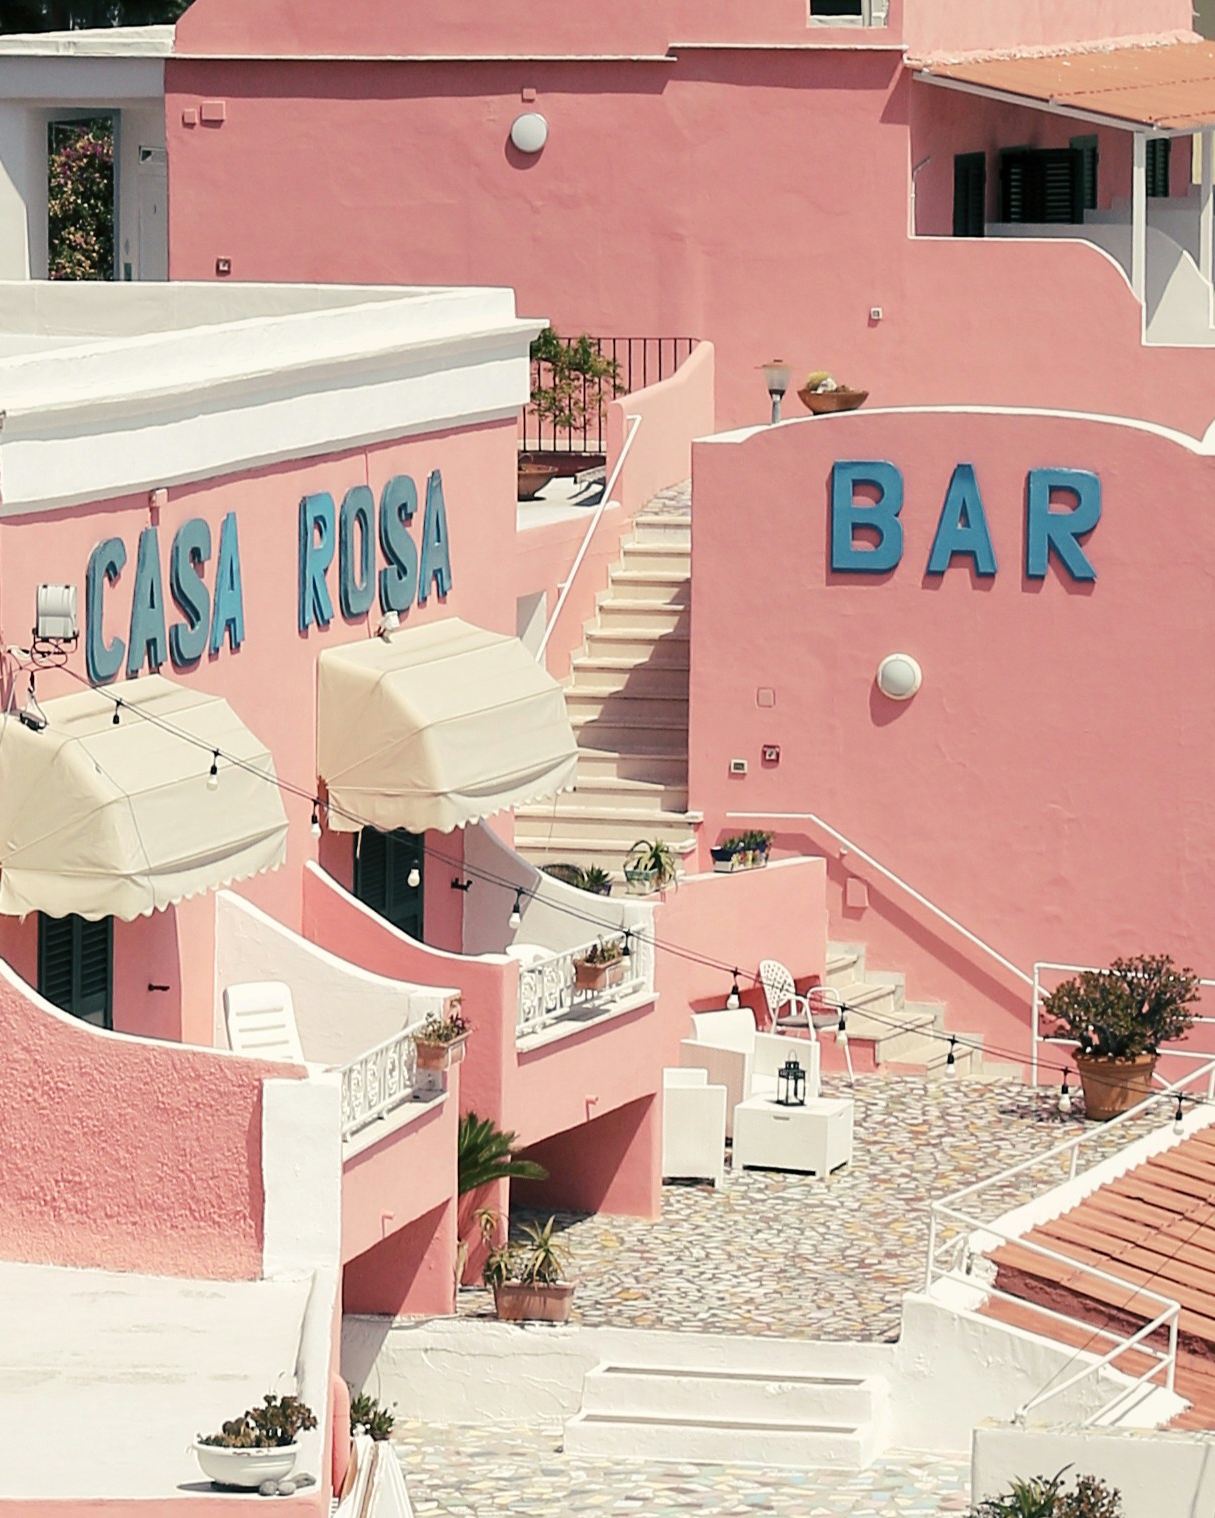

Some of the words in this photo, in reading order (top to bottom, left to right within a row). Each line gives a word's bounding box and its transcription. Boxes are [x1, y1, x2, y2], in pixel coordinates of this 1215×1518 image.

[85, 511, 246, 685] CASA
[298, 468, 453, 632] ROSA
[829, 460, 1102, 582] BAR
